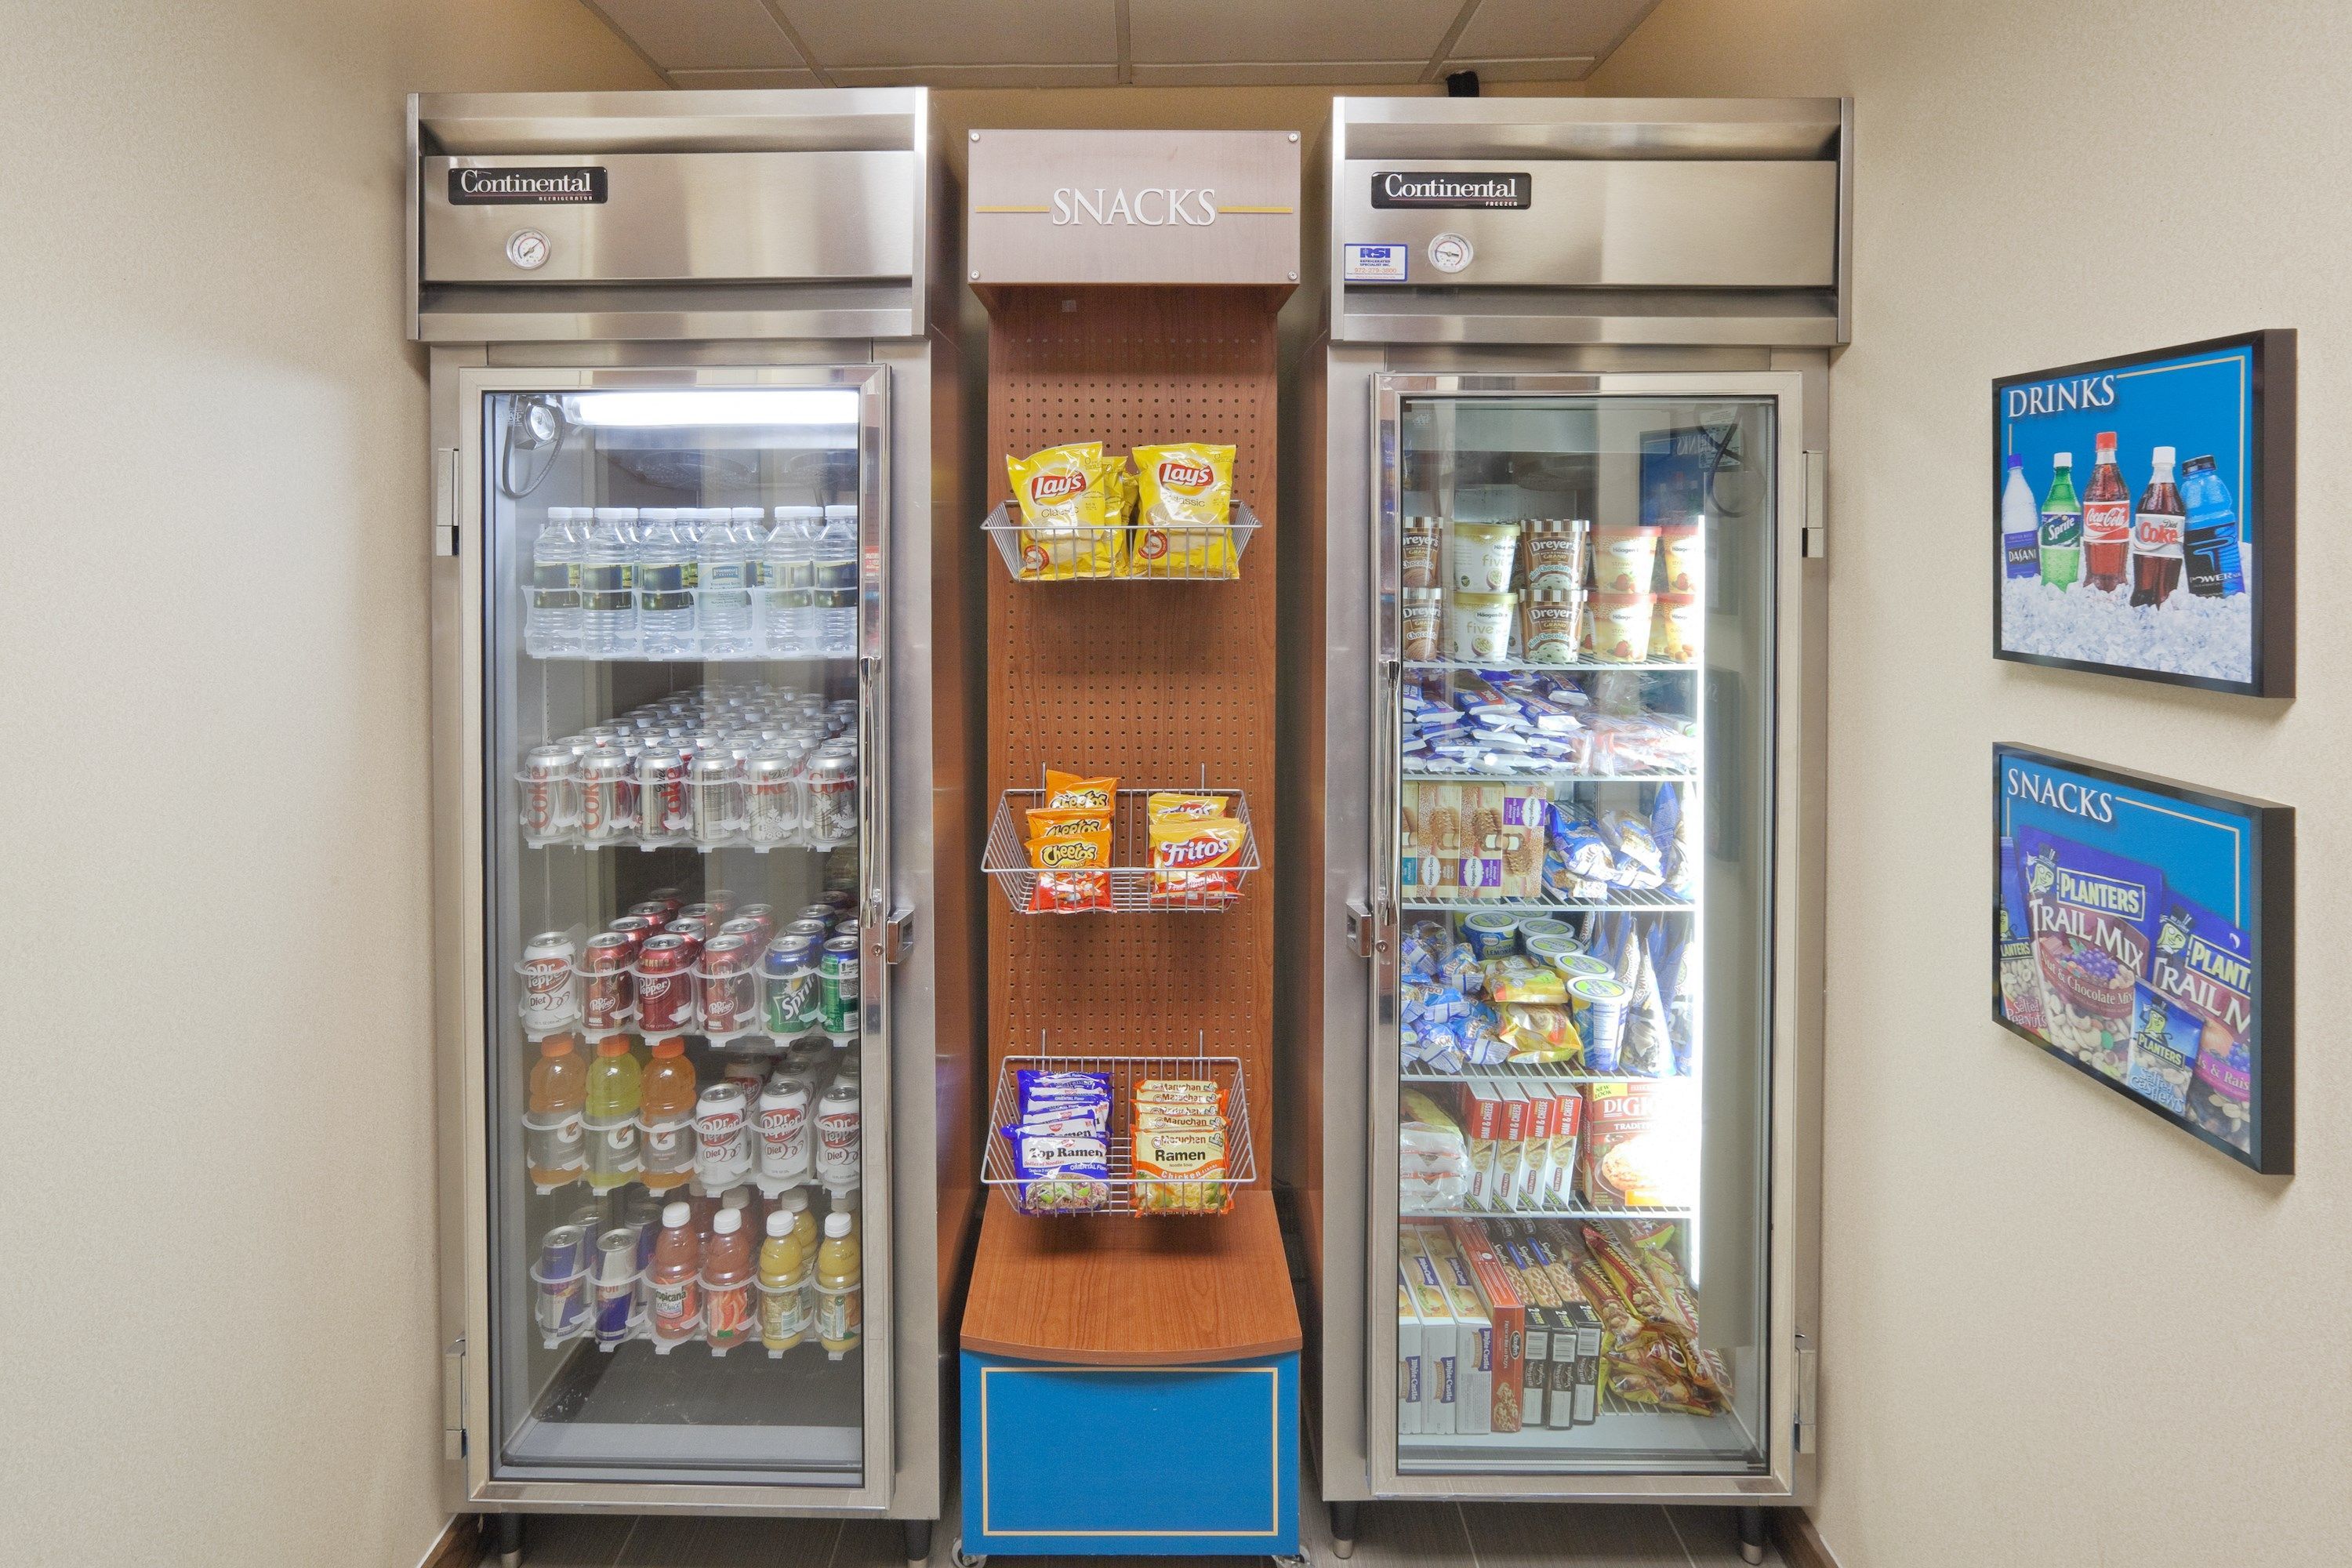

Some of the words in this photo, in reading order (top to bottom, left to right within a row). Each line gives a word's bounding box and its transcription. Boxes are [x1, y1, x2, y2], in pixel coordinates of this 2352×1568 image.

[461, 169, 592, 193] Continental
[1385, 173, 1517, 198] Continental
[1052, 187, 1216, 226] SNACKS
[1360, 248, 1390, 258] RSI
[2008, 375, 2114, 418] DRINKS
[1163, 464, 1210, 485] Lay's
[1035, 474, 1082, 499] Lay's
[2087, 507, 2125, 527] Coca-Cola
[2163, 519, 2178, 528] Diet
[2049, 517, 2074, 540] Sprite
[2140, 521, 2178, 544] Coke
[2009, 549, 2036, 562] DASANI
[1466, 622, 1494, 634] five
[582, 768, 599, 830] Coke
[2008, 768, 2112, 823] SNACKS
[1042, 843, 1097, 866] Cheetos
[1161, 840, 1229, 867] Fritos
[2061, 873, 2139, 914] PLANTERS
[2029, 898, 2092, 941] TRAIL
[2094, 917, 2143, 977] MIX
[2002, 942, 2030, 956] LANTERS
[2190, 941, 2251, 993] PLANT
[2041, 949, 2056, 973] Nut
[2058, 971, 2067, 984] &
[2067, 976, 2114, 1005] Chocolate
[2117, 993, 2133, 1005] Mix
[639, 978, 668, 996] Pepper
[530, 996, 546, 1006] Diet
[590, 999, 614, 1011] Pepper
[709, 1002, 732, 1014] Pepper
[2013, 1000, 2039, 1014] Salted
[2139, 1033, 2182, 1065] PLANTERS
[2210, 1064, 2220, 1078] &
[2224, 1071, 2250, 1091] Rais
[1595, 1091, 1611, 1099] LOOK
[1483, 1102, 1494, 1120] CHEESE
[1511, 1104, 1522, 1122] CHEESE
[1537, 1101, 1548, 1119] CHEESE
[1563, 1098, 1574, 1116] CHEESE
[1480, 1126, 1490, 1139] HAM
[1508, 1127, 1519, 1140] HAM
[1534, 1125, 1544, 1137] HAM
[1561, 1123, 1570, 1134] HAM
[1161, 1135, 1206, 1144] Maruchan
[706, 1149, 720, 1159] Diet
[768, 1145, 782, 1155] Diet
[827, 1152, 842, 1161] Diet
[1057, 1148, 1102, 1157] Ramen
[1156, 1149, 1205, 1161] Ramen
[1161, 1171, 1200, 1179] Chicken
[1579, 1265, 1594, 1279] STEAK
[1595, 1279, 1613, 1298] CHEESE
[655, 1290, 686, 1302] ropicana
